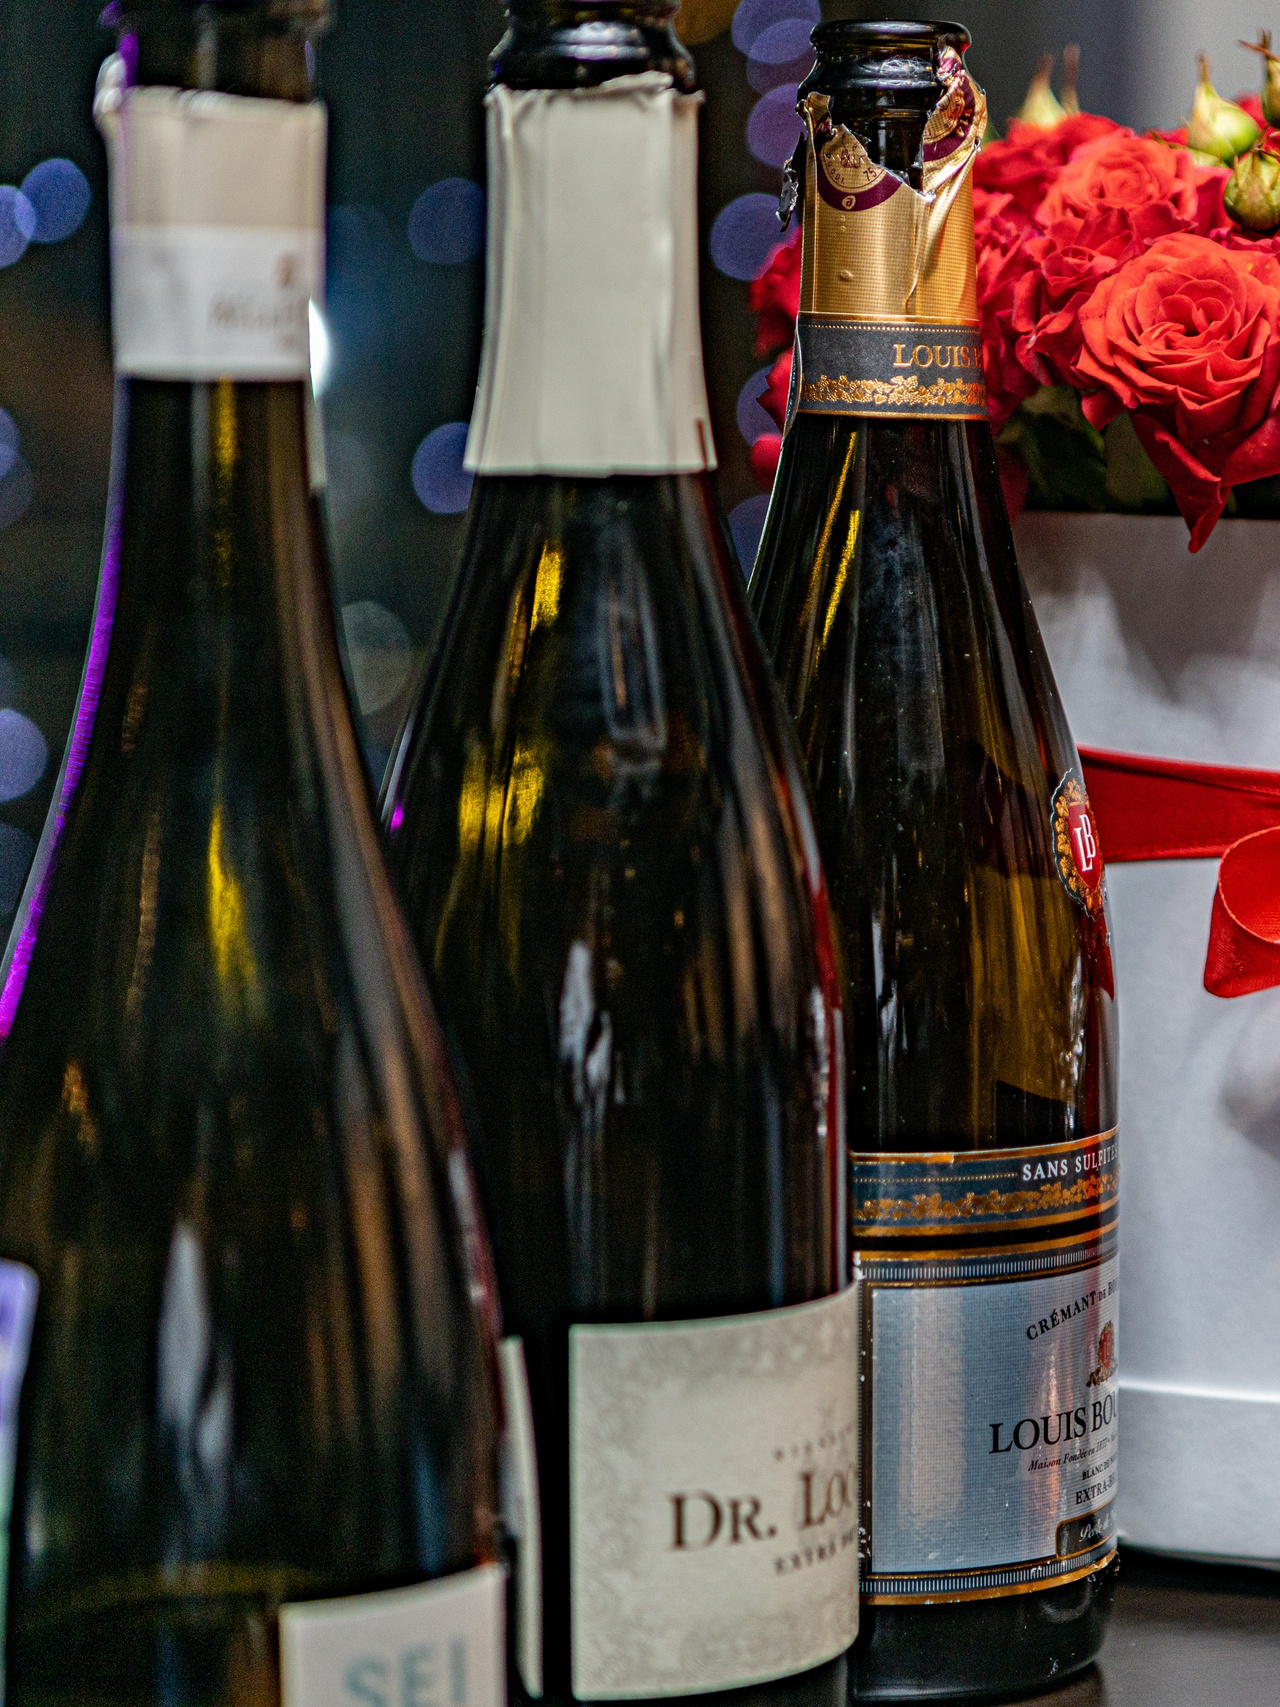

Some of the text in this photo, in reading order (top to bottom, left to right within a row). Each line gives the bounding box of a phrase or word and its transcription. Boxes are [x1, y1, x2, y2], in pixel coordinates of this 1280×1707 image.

[892, 343, 971, 368] LOUIS
[1021, 1158, 1068, 1181] SANS
[1026, 1290, 1097, 1341] CRÉMANT
[988, 1406, 1088, 1454] LOUIS
[1027, 1457, 1061, 1472] Maison
[1081, 1464, 1104, 1481] BLANC
